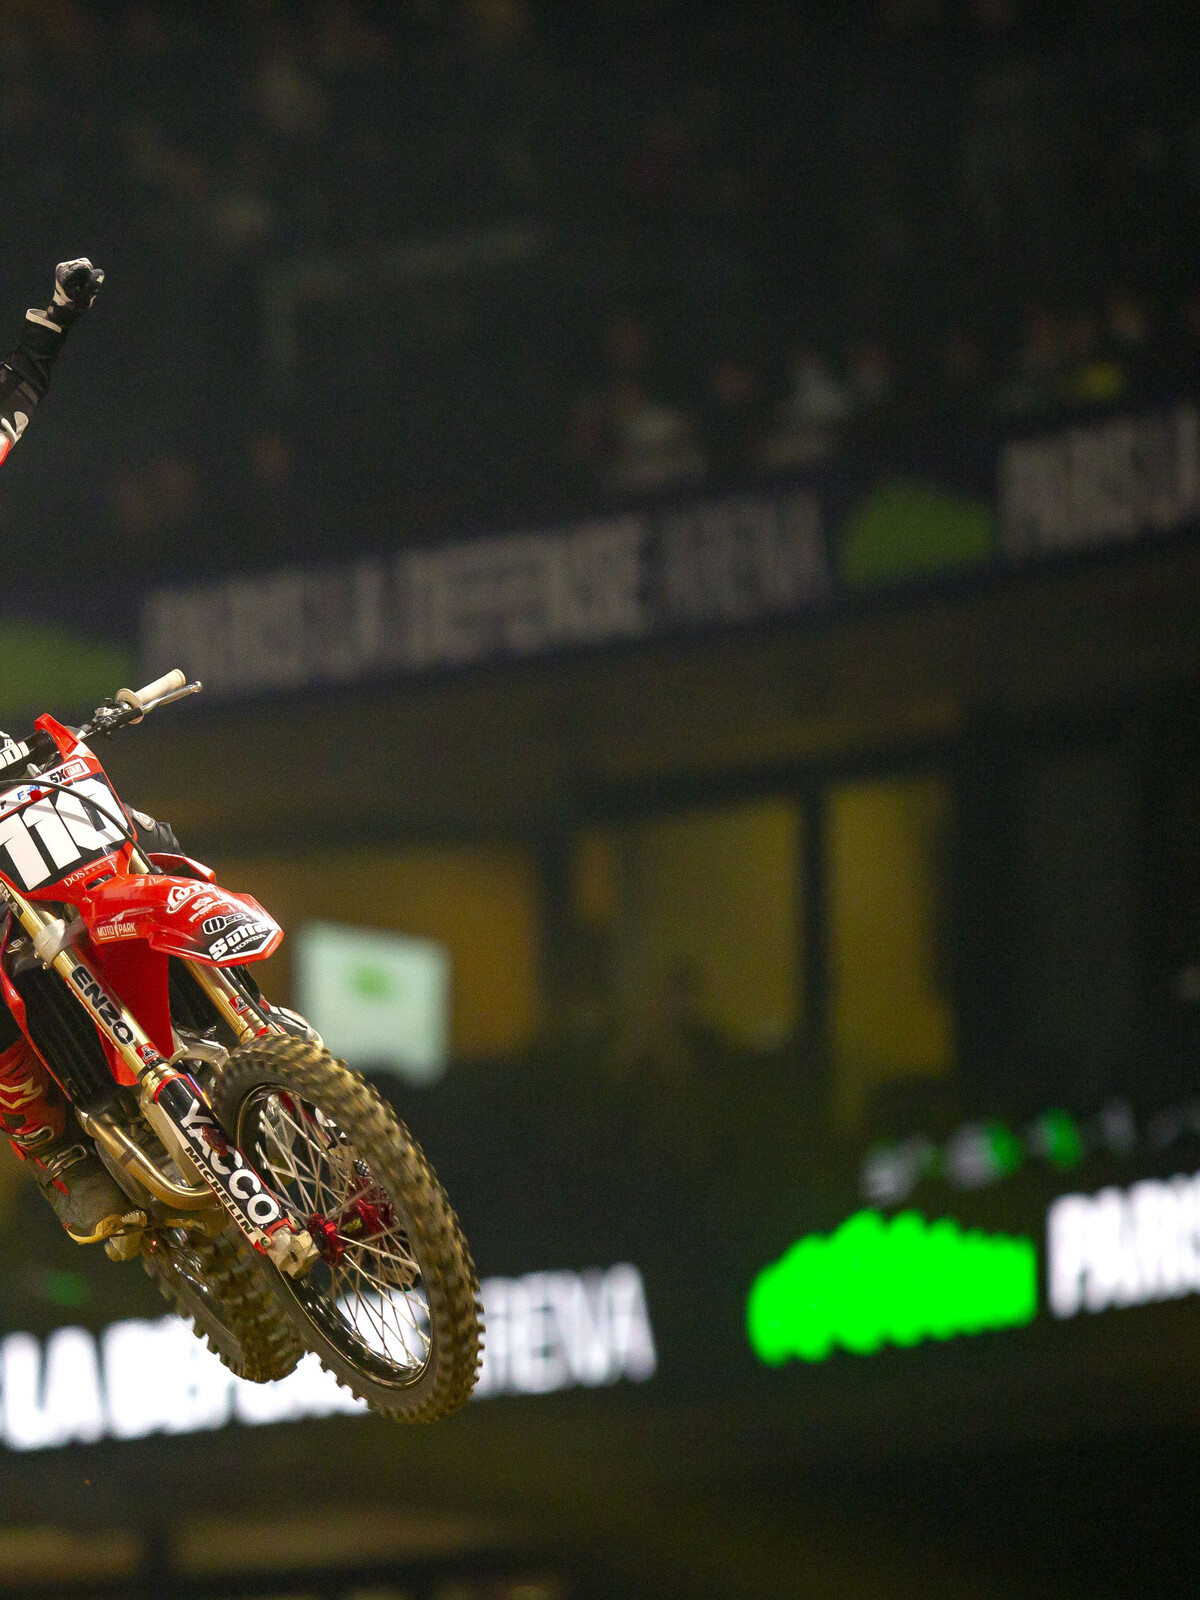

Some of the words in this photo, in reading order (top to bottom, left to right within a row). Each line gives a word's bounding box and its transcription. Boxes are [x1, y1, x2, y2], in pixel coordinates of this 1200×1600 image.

[63, 870, 86, 888] DOS
[97, 926, 114, 936] MOTO
[118, 922, 136, 934] PARK
[71, 964, 137, 1045] ENZO
[184, 1146, 255, 1235] MICHELIN
[3, 1326, 102, 1452] LA
[470, 1262, 658, 1400] RENA
